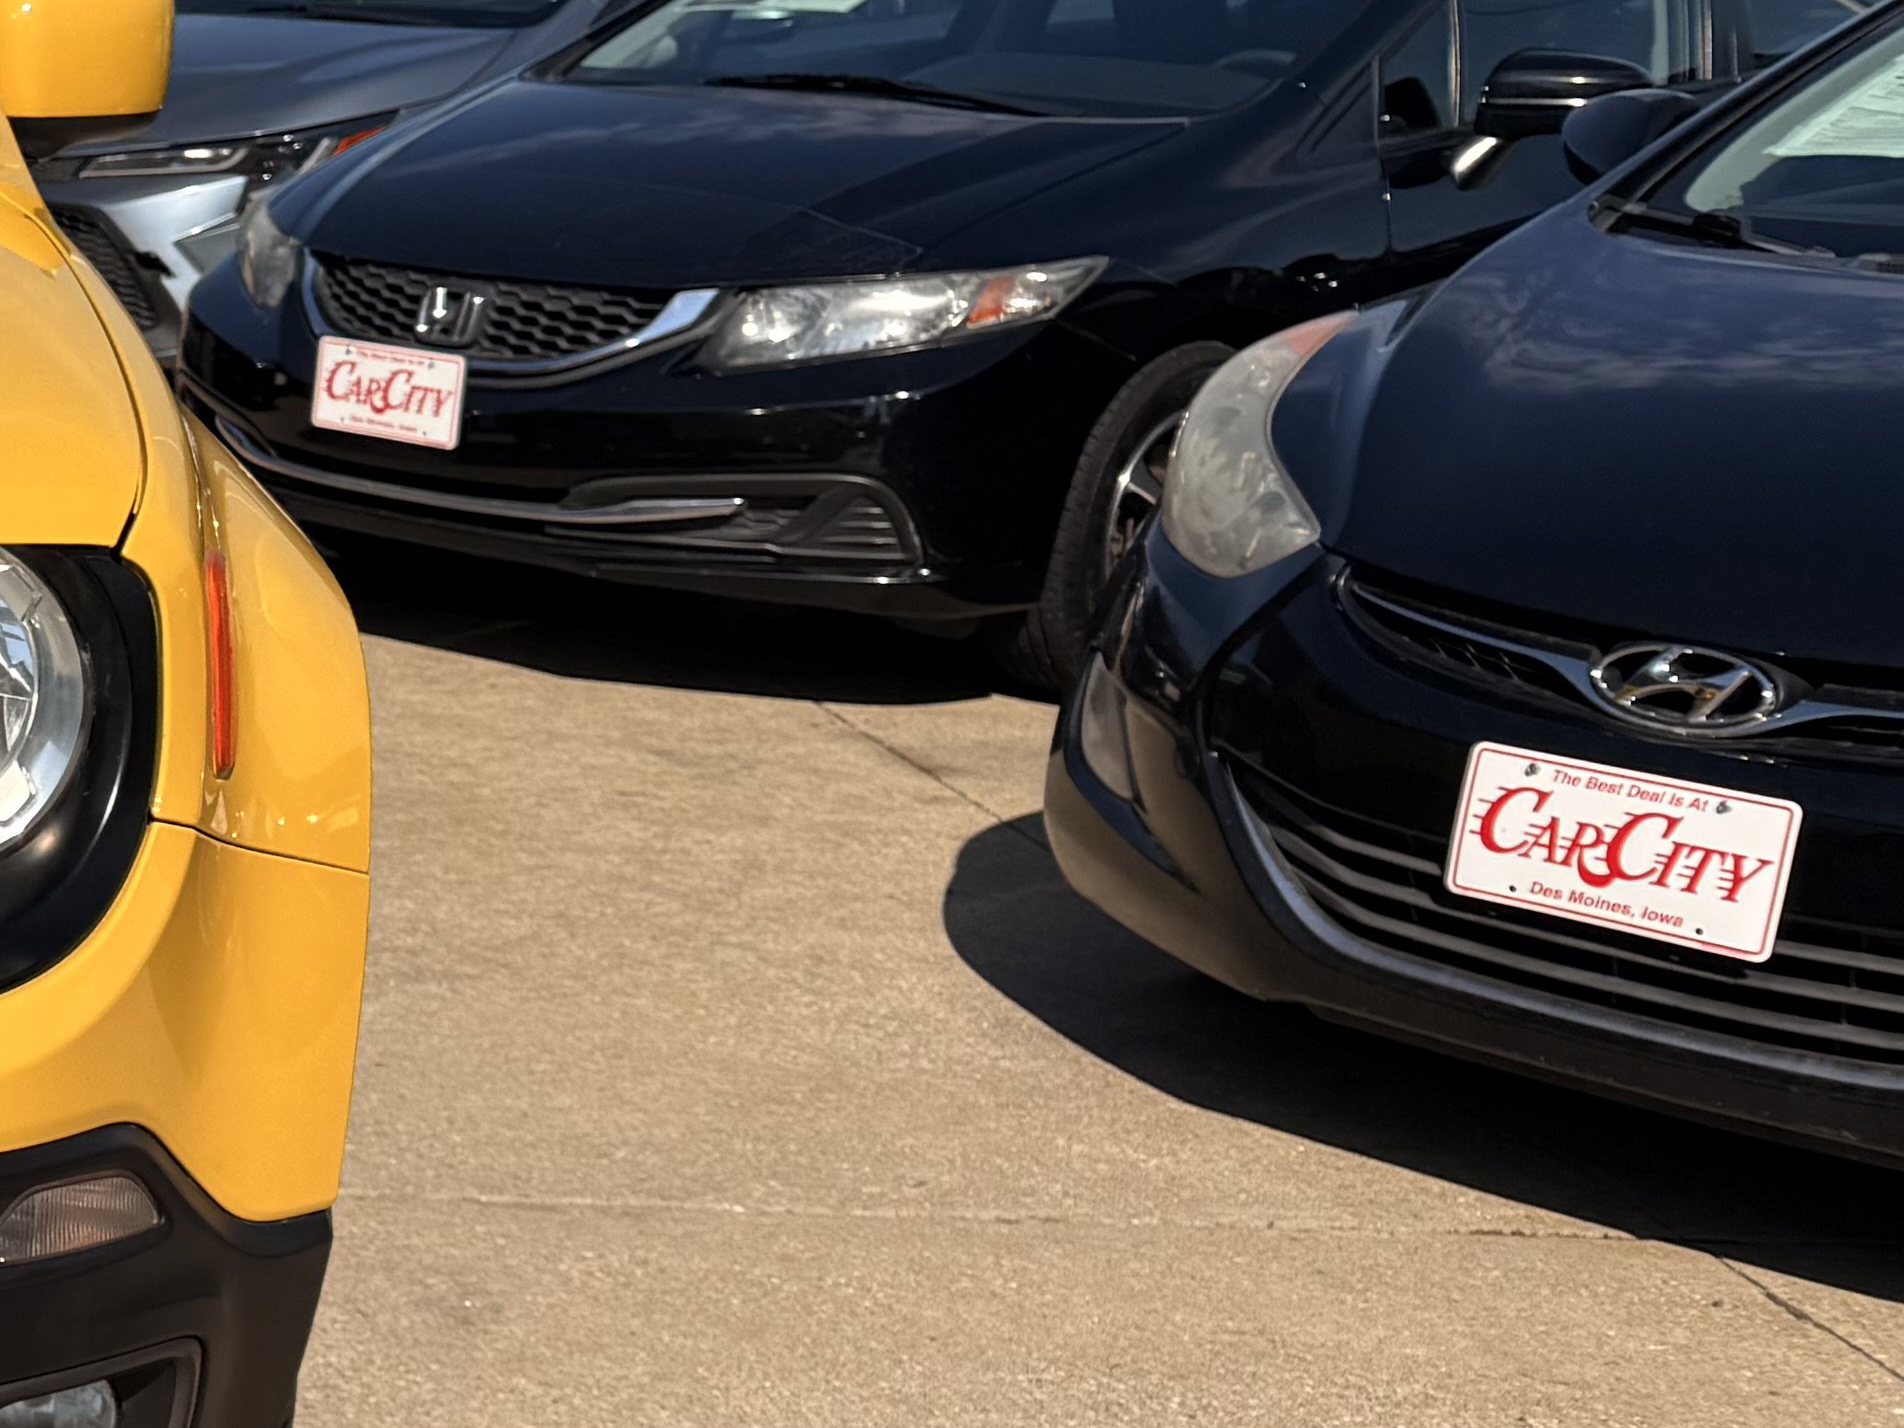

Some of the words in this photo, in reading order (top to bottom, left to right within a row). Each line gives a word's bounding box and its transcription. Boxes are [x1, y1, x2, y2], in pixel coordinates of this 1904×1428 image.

[1552, 769, 1581, 787] The
[1585, 776, 1624, 796] Best
[1627, 784, 1666, 804] Deal
[1688, 797, 1710, 813] At
[1529, 880, 1564, 900] Des
[1568, 889, 1636, 919] Moines,
[1641, 906, 1685, 928] Iowa
